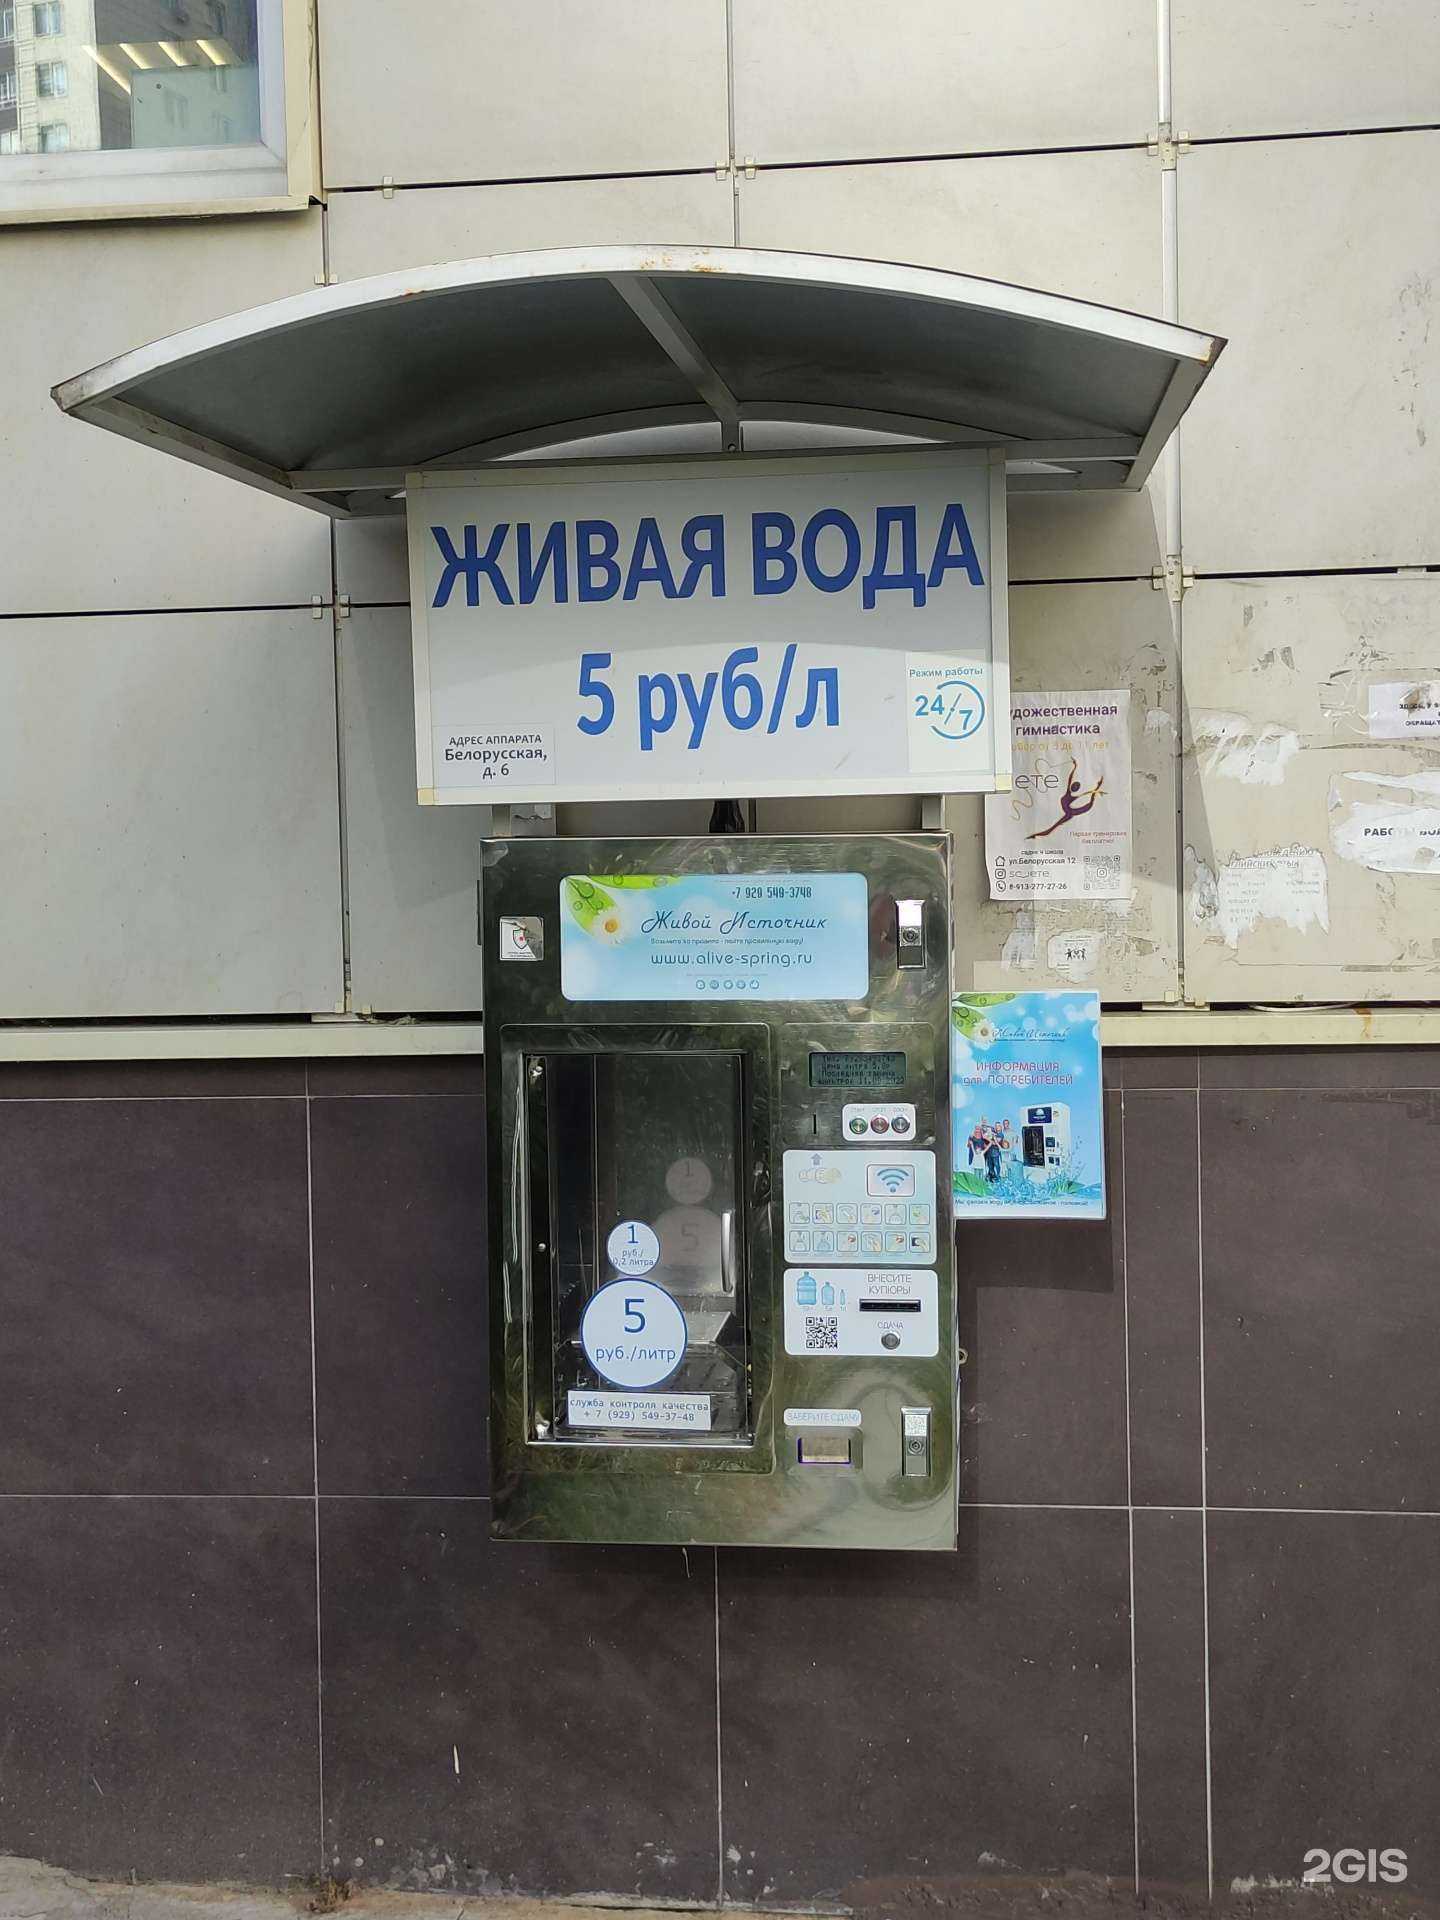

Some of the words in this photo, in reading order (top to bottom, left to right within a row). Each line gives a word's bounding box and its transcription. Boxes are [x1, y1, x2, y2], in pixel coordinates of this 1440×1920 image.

[431, 513, 726, 608] ЖИВАЯ
[751, 502, 985, 610] ВОДА
[909, 667, 942, 679] Режим
[944, 665, 983, 679] работы
[577, 652, 615, 736] 5
[638, 643, 840, 751] руб/л
[914, 692, 974, 731] 24/7
[1015, 724, 1101, 736] гимнастика
[449, 735, 483, 747] АДРЕС
[485, 733, 542, 746] АППАРАТА
[445, 747, 548, 763] Белорусская,
[482, 765, 496, 779] д.
[499, 763, 510, 778] 6
[641, 910, 713, 933] Живой
[719, 911, 828, 934] Источник
[651, 952, 812, 967] www.alive-spring.ru
[976, 1061, 1060, 1072] ИНФОРМАЦИЯ
[987, 1074, 1073, 1085] ПОТРЕБИТЕЛЕЙ
[626, 1224, 639, 1244] 1
[622, 1249, 643, 1259] руб./
[629, 1258, 654, 1267] литра
[867, 1273, 912, 1283] ВНЕСИТЕ
[868, 1284, 911, 1295] КУПЮРЫ
[623, 1298, 646, 1333] 5
[877, 1321, 904, 1330] СДАЧА
[595, 1346, 676, 1363] руб./литр
[569, 1397, 604, 1409] служба
[609, 1399, 656, 1410] контроля
[662, 1401, 710, 1412] качества
[596, 1410, 602, 1418] 7
[608, 1410, 636, 1421] (929)
[641, 1411, 695, 1422] 549-37-48
